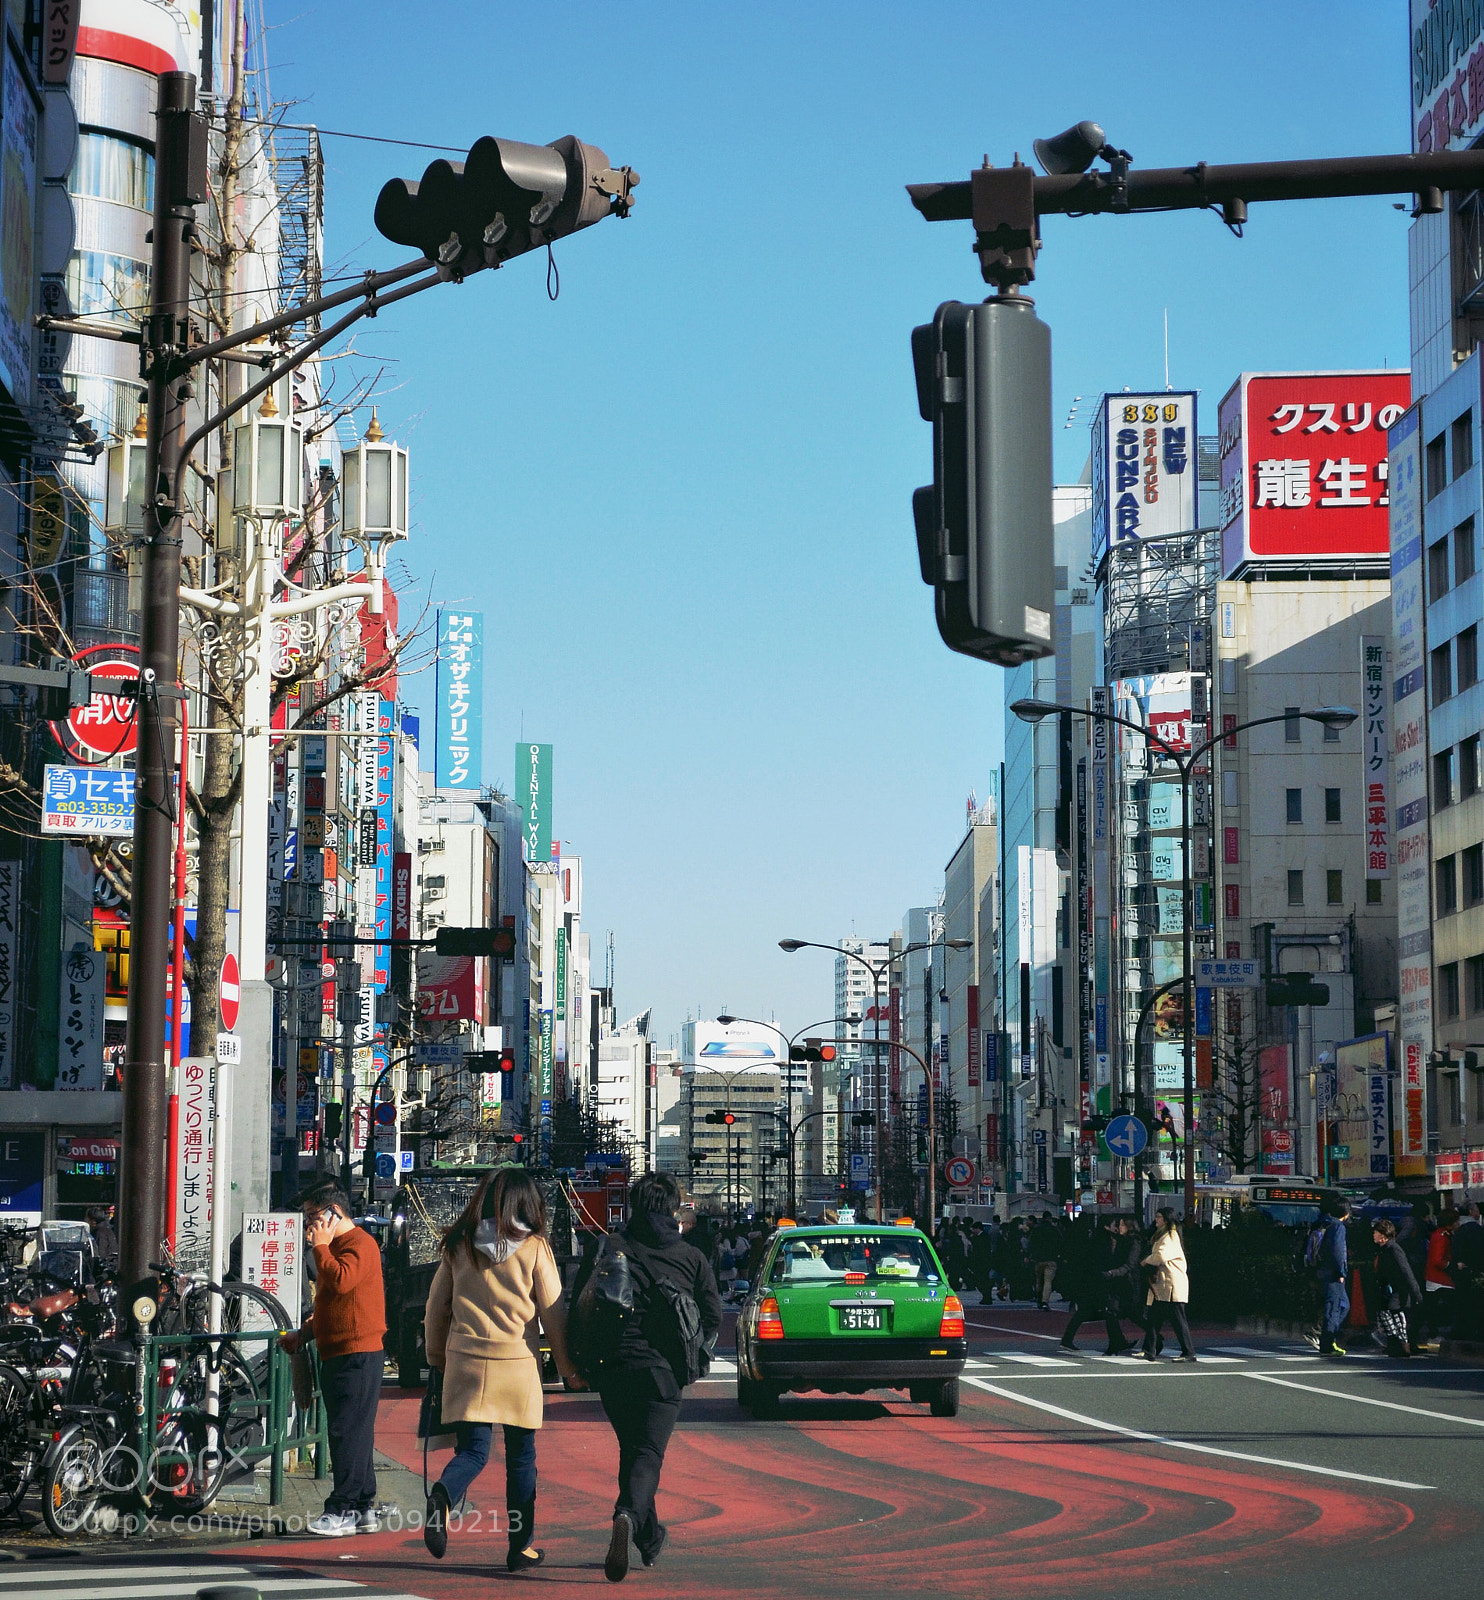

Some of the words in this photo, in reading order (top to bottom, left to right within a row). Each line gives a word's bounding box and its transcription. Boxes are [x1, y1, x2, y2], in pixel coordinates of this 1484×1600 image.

[1413, 0, 1484, 108] SUNPAR
[1123, 403, 1178, 423] 389
[1144, 427, 1159, 504] SHINJUKU
[1162, 427, 1187, 475] NEW
[1114, 428, 1142, 541] SUNPARK
[449, 645, 472, 784] オザキクリニック
[1366, 646, 1384, 771] 新宿サンパーク
[48, 770, 77, 800] 質
[365, 753, 375, 803] TSUTAYA
[530, 745, 540, 820] ORIENTAL
[1195, 780, 1205, 823] MOUTON
[48, 814, 77, 828] 買取
[528, 823, 540, 860] WAVE
[1368, 784, 1386, 870] 三平本館
[396, 868, 408, 930] SHIDAX
[1202, 963, 1254, 975] 歌舞伎町
[62, 984, 85, 1084] とらそば
[361, 989, 371, 1041] TSUTAYA
[1406, 1045, 1417, 1084] GAME
[848, 1316, 880, 1328] 51-41
